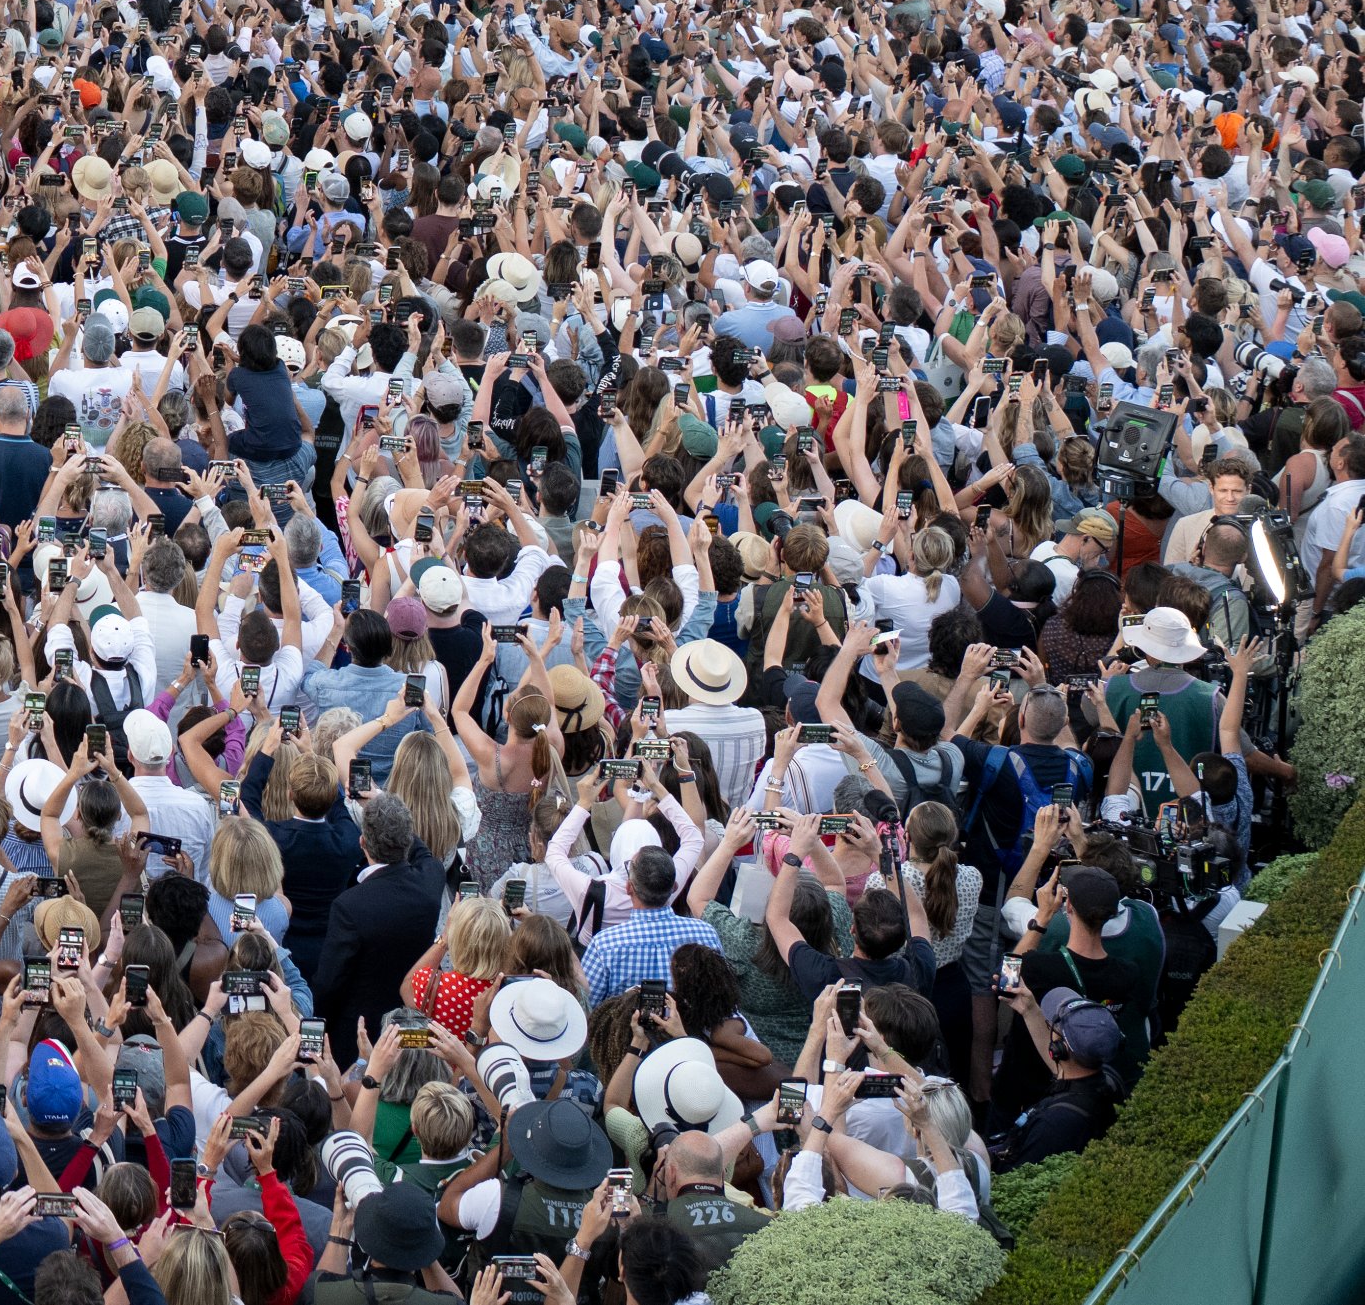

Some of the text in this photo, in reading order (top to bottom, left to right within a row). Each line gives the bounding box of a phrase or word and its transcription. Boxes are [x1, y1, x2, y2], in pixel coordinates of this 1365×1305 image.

[540, 1196, 588, 1209] WIMBLEDO
[685, 1200, 735, 1210] WIMBLEDON
[690, 1206, 736, 1226] 226
